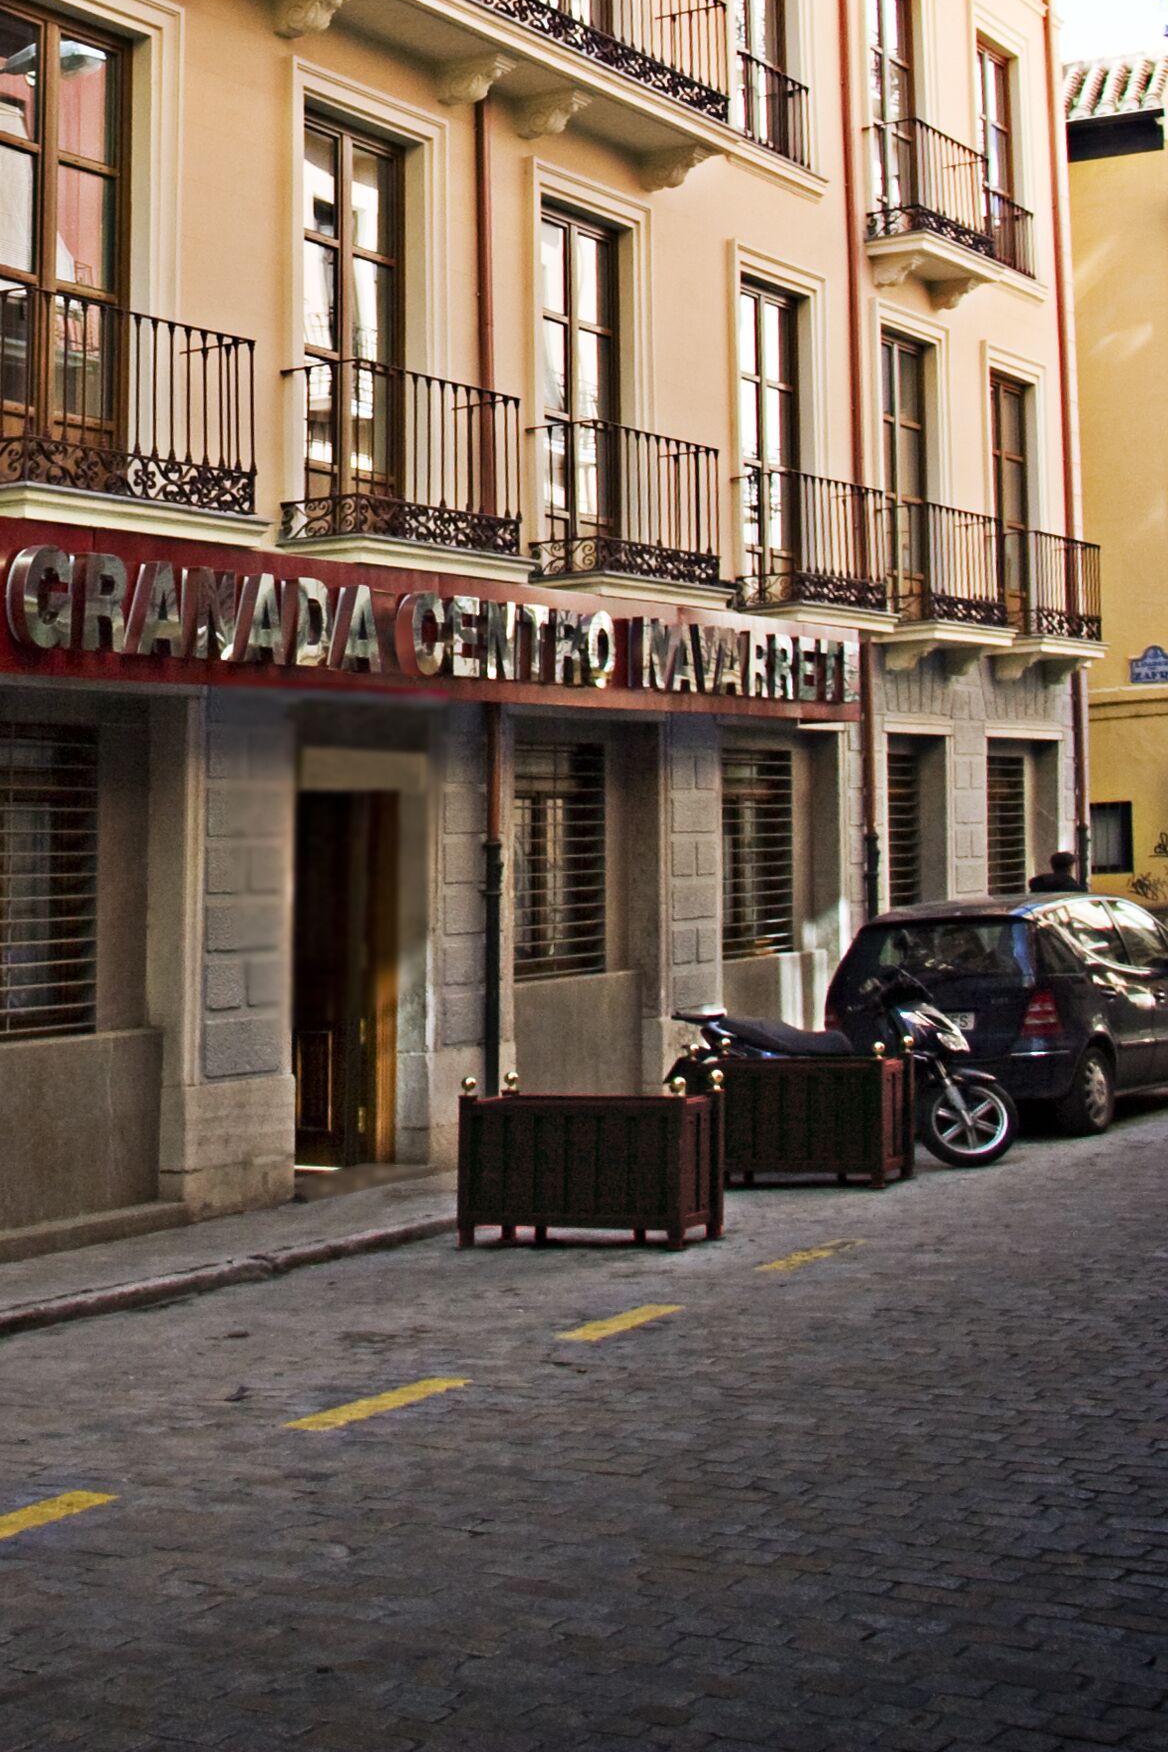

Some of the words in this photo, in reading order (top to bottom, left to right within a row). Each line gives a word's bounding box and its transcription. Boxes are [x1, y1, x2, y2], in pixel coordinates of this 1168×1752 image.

[5, 544, 382, 674] GRANADA
[395, 590, 616, 689] CENTRO
[629, 616, 861, 704] NAVARRETE
